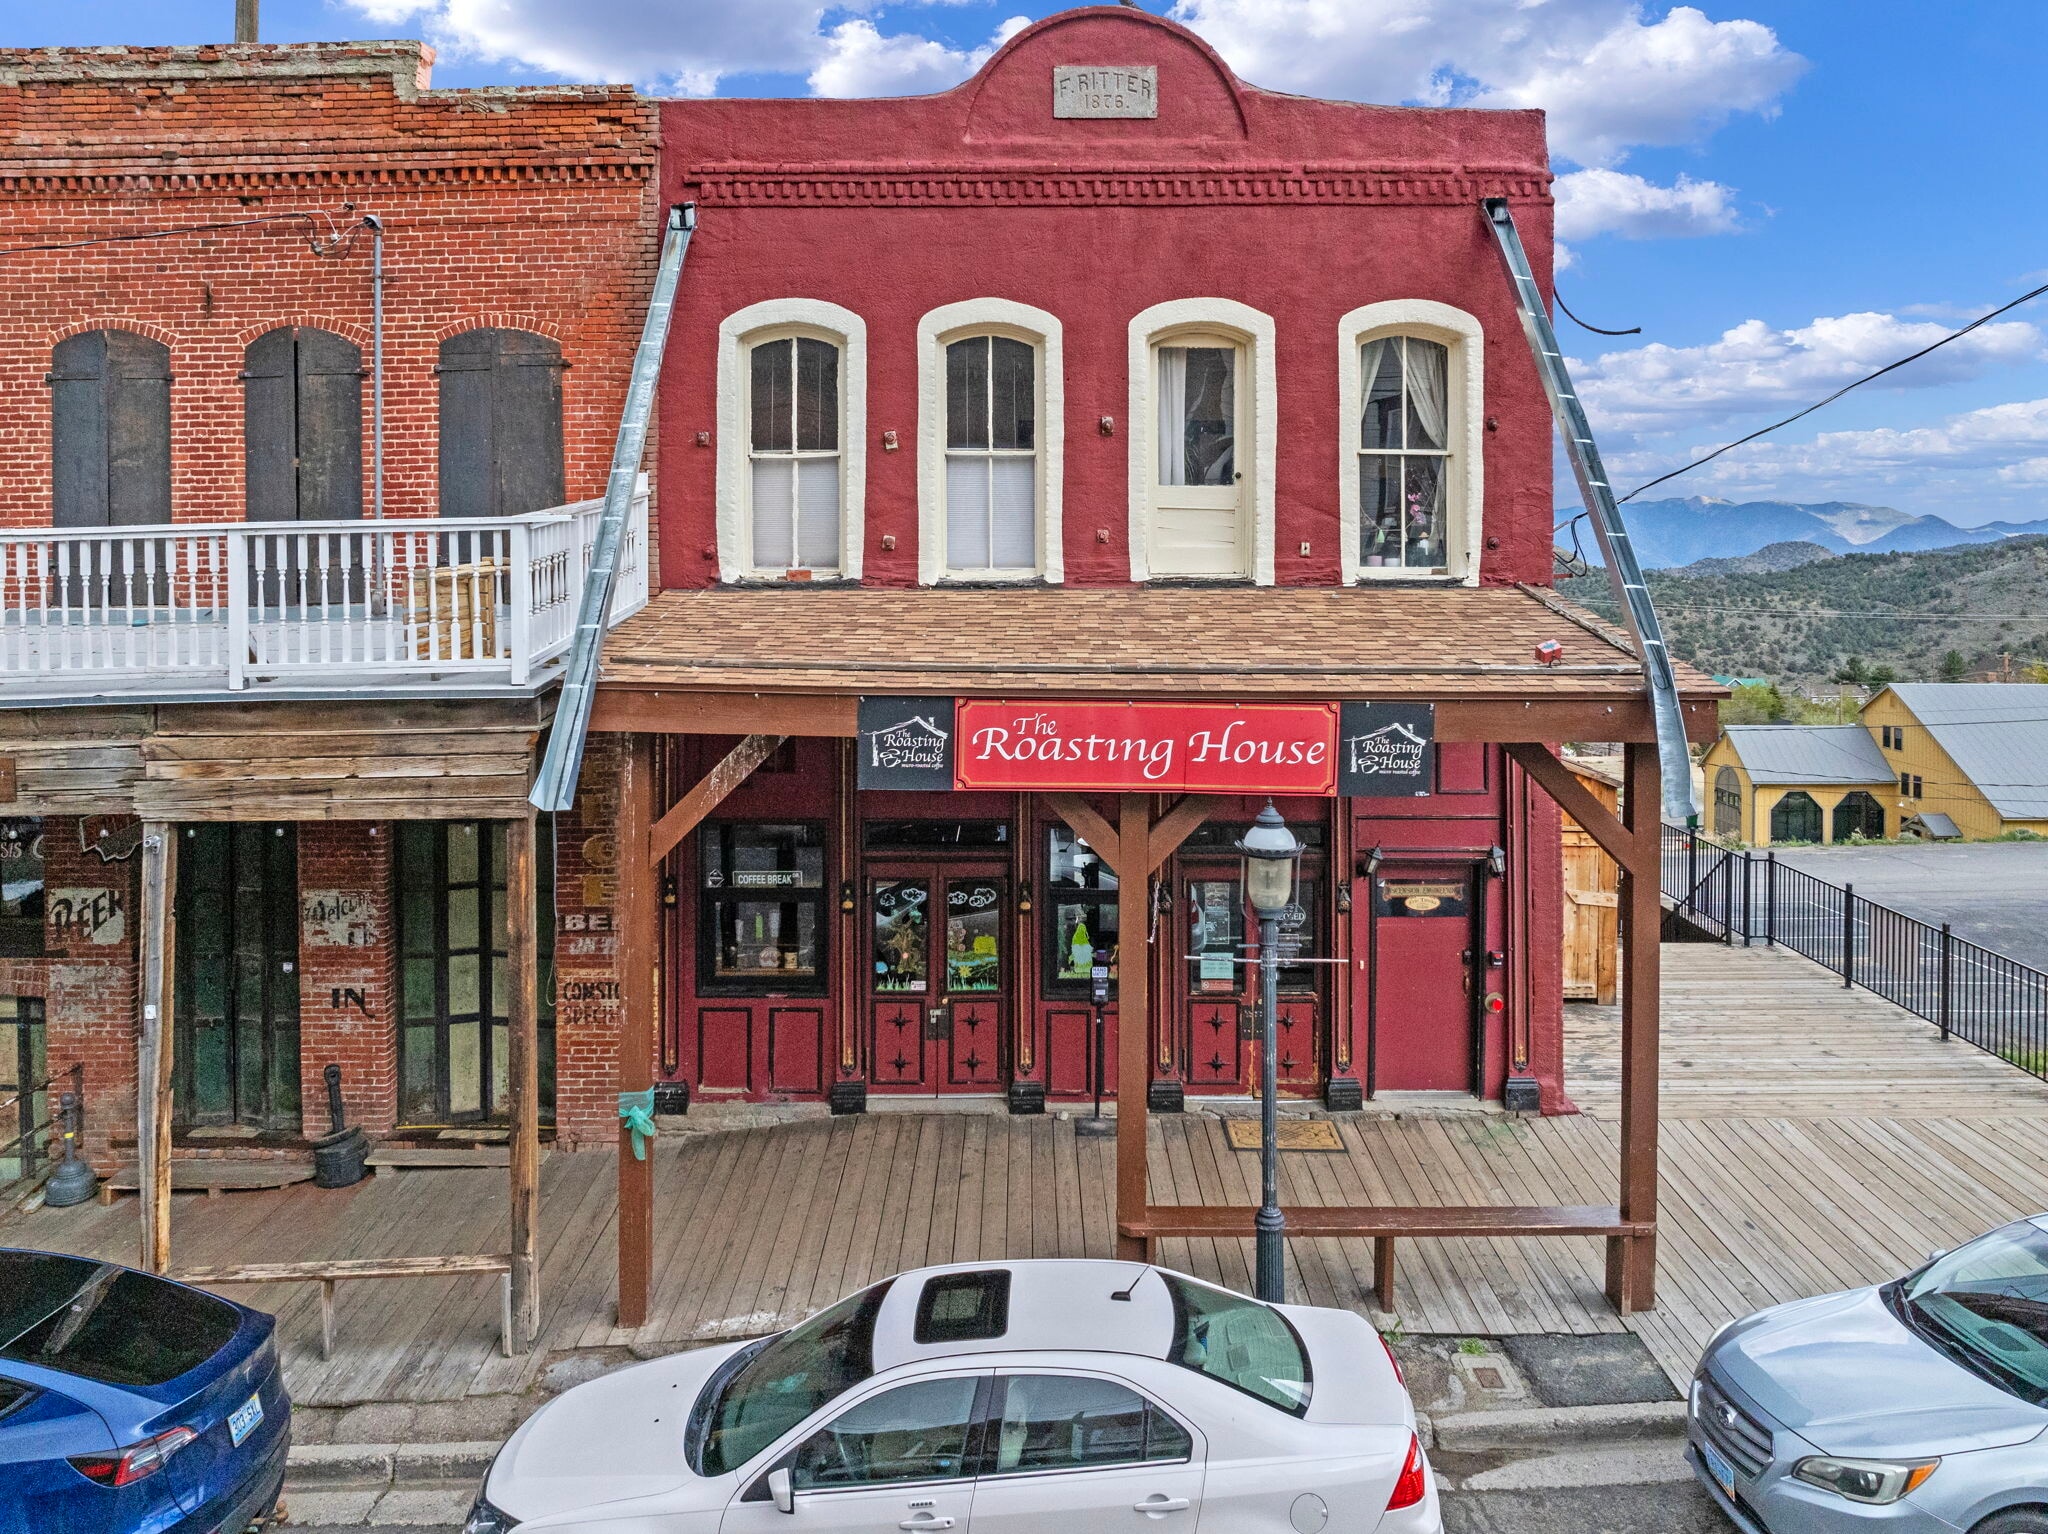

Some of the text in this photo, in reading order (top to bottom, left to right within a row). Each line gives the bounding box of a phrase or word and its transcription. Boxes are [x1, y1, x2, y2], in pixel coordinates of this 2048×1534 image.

[1013, 712, 1057, 735] The
[895, 728, 911, 738] The
[1374, 735, 1390, 744] The
[883, 733, 945, 753] Roasting
[972, 720, 1325, 779] Roasting House
[1362, 741, 1423, 760] Roasting
[901, 746, 944, 762] House
[1379, 752, 1421, 769] House
[738, 875, 766, 885] COFFEE
[767, 875, 792, 885] BREAK
[331, 988, 376, 1018] IN
